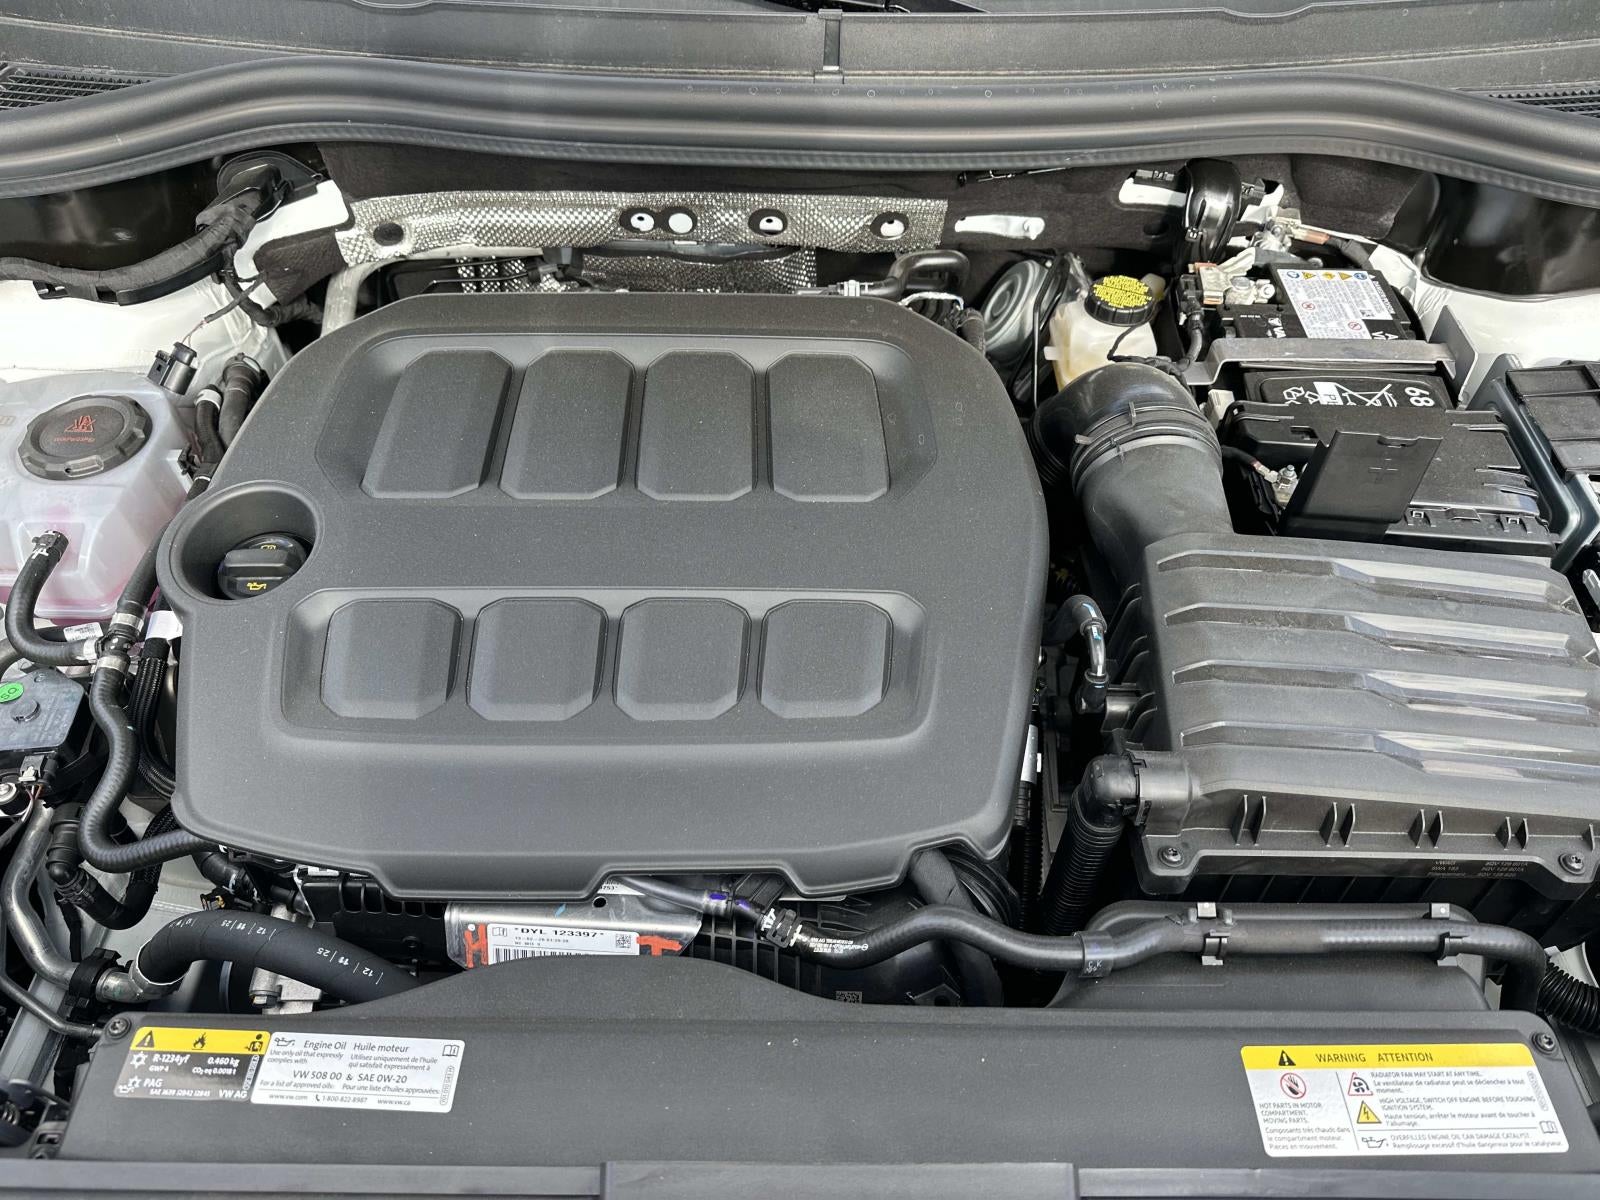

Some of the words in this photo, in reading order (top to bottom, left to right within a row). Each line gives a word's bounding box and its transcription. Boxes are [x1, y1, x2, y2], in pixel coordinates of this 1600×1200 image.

[1404, 386, 1435, 406] 68
[304, 1040, 332, 1050] Engine
[334, 1041, 346, 1050] Oil
[354, 1042, 376, 1051] Huile
[153, 1054, 190, 1066] R-1234yf
[1316, 1053, 1366, 1062] WARNING
[1378, 1052, 1434, 1062] ATTENTION
[208, 1057, 229, 1066] 0.460
[230, 1058, 240, 1068] kg
[293, 1070, 310, 1078] VW
[311, 1071, 328, 1080] 508
[330, 1072, 342, 1080] 00
[346, 1073, 354, 1081] &
[358, 1074, 374, 1082] SAE
[376, 1074, 408, 1084] 0W-20
[144, 1078, 162, 1088] PAG
[218, 1090, 234, 1098] VW
[234, 1090, 247, 1098] AG
